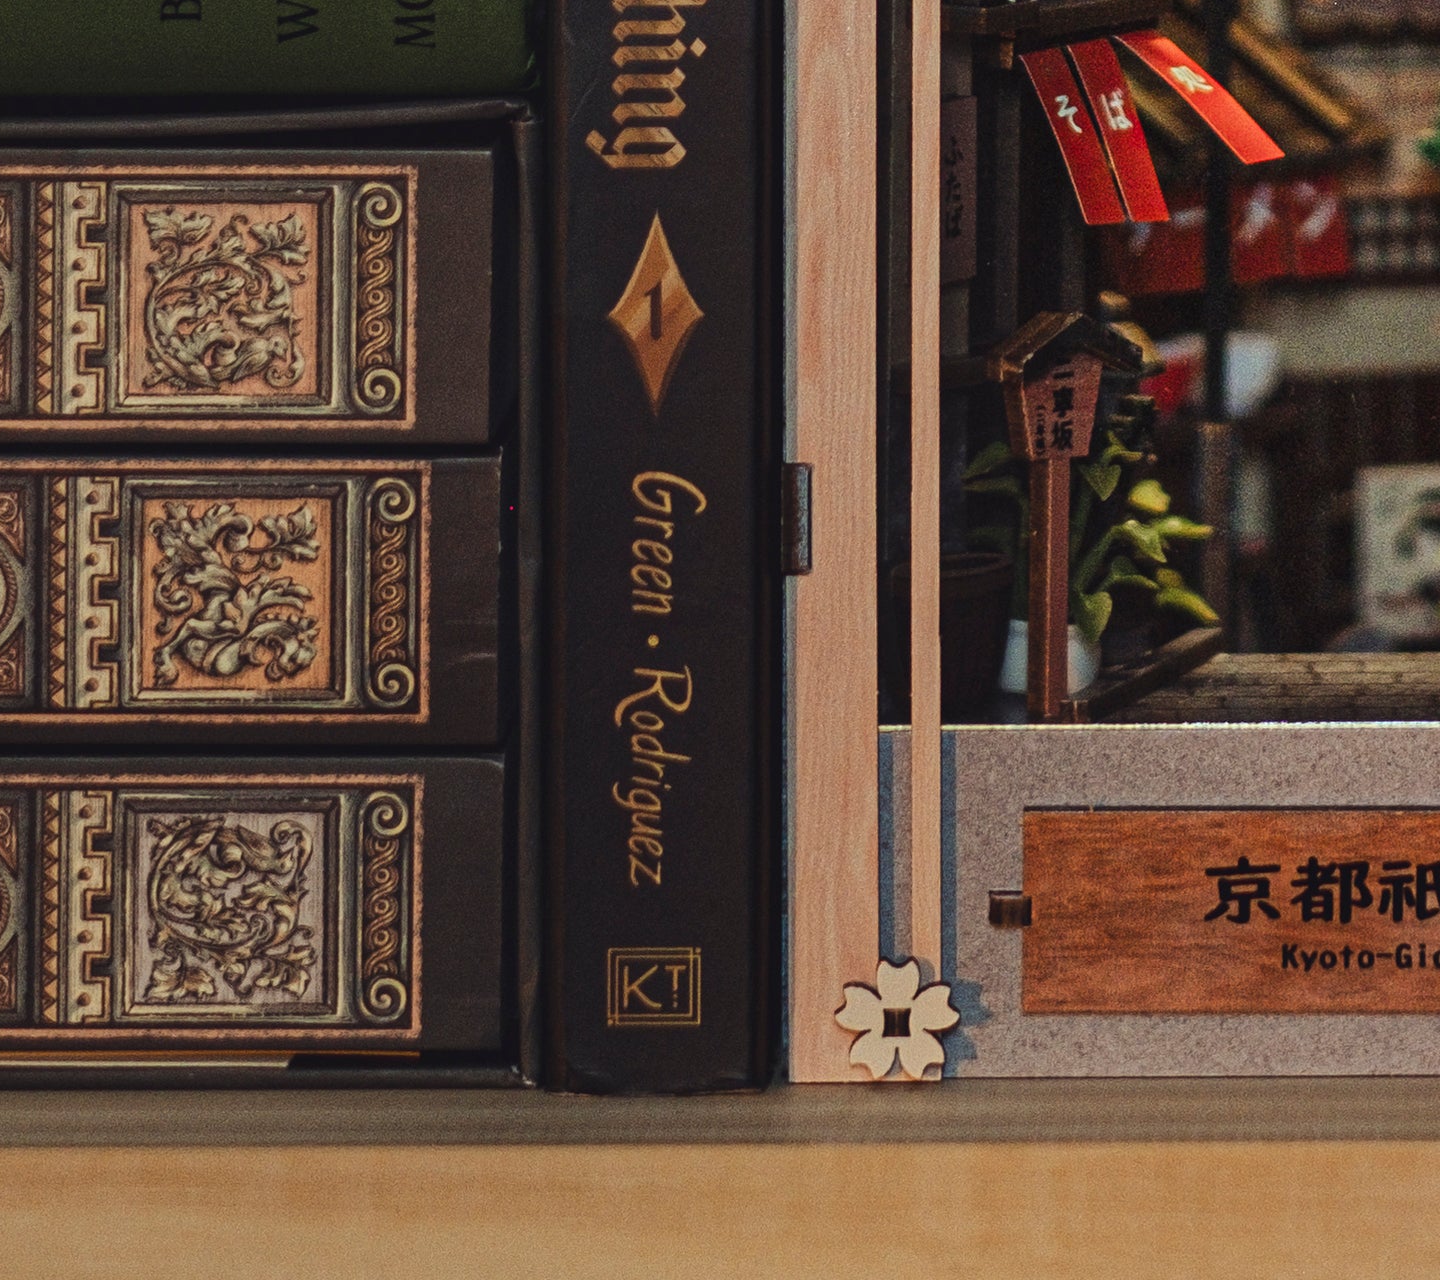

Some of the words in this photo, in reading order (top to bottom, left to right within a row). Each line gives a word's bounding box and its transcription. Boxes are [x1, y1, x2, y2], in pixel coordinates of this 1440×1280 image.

[644, 281, 662, 340] 1
[632, 470, 707, 613] Green
[613, 665, 693, 887] Rodriguez
